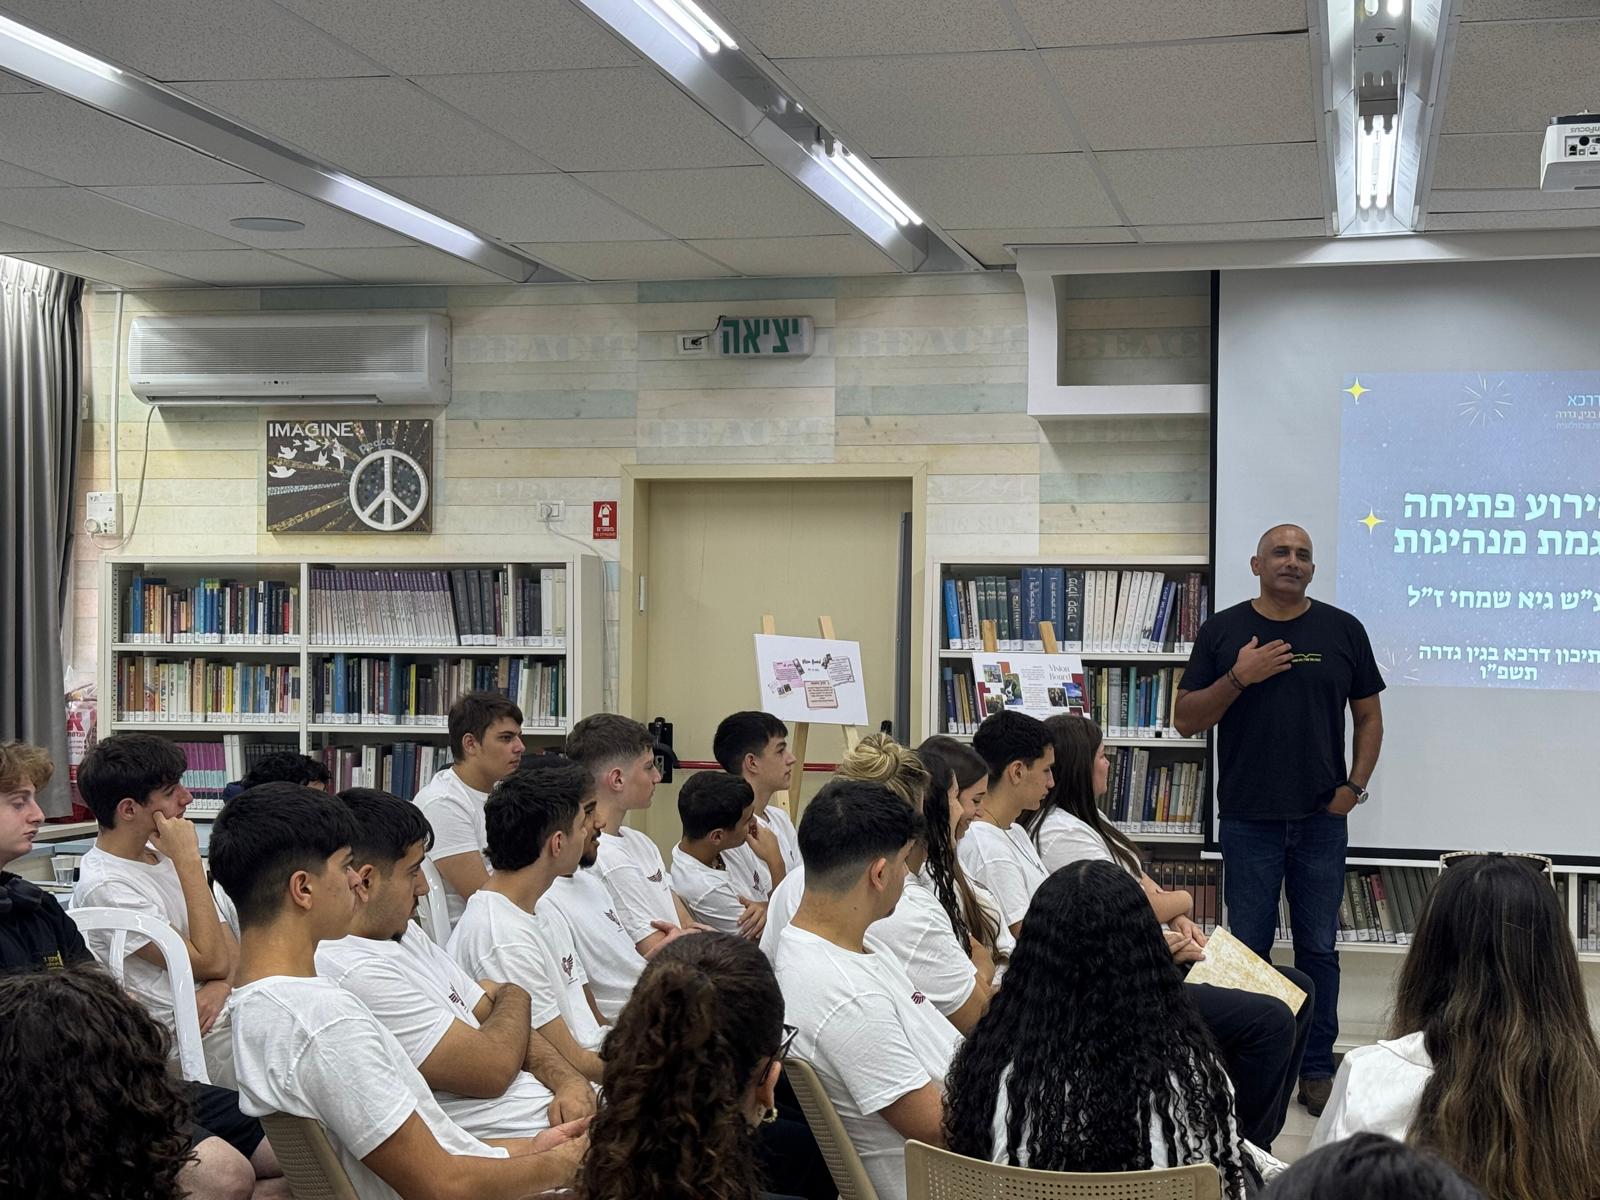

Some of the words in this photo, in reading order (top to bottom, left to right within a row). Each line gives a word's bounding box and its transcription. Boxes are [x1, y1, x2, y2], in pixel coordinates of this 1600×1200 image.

[722, 319, 799, 353] יציאה
[1567, 394, 1600, 406] דרכא
[269, 422, 354, 437] IMAGINE
[1404, 492, 1515, 518] פתיחה
[1525, 493, 1600, 520] ירוע
[1393, 528, 1527, 555] מנהיגות
[1537, 529, 1600, 556] גמת
[1449, 590, 1512, 609] שמחי
[1518, 591, 1554, 610] גיא
[1419, 645, 1461, 660] גדרה
[1466, 646, 1499, 663] בגין
[1504, 647, 1551, 662] דרכא
[1555, 648, 1600, 665] תיכון
